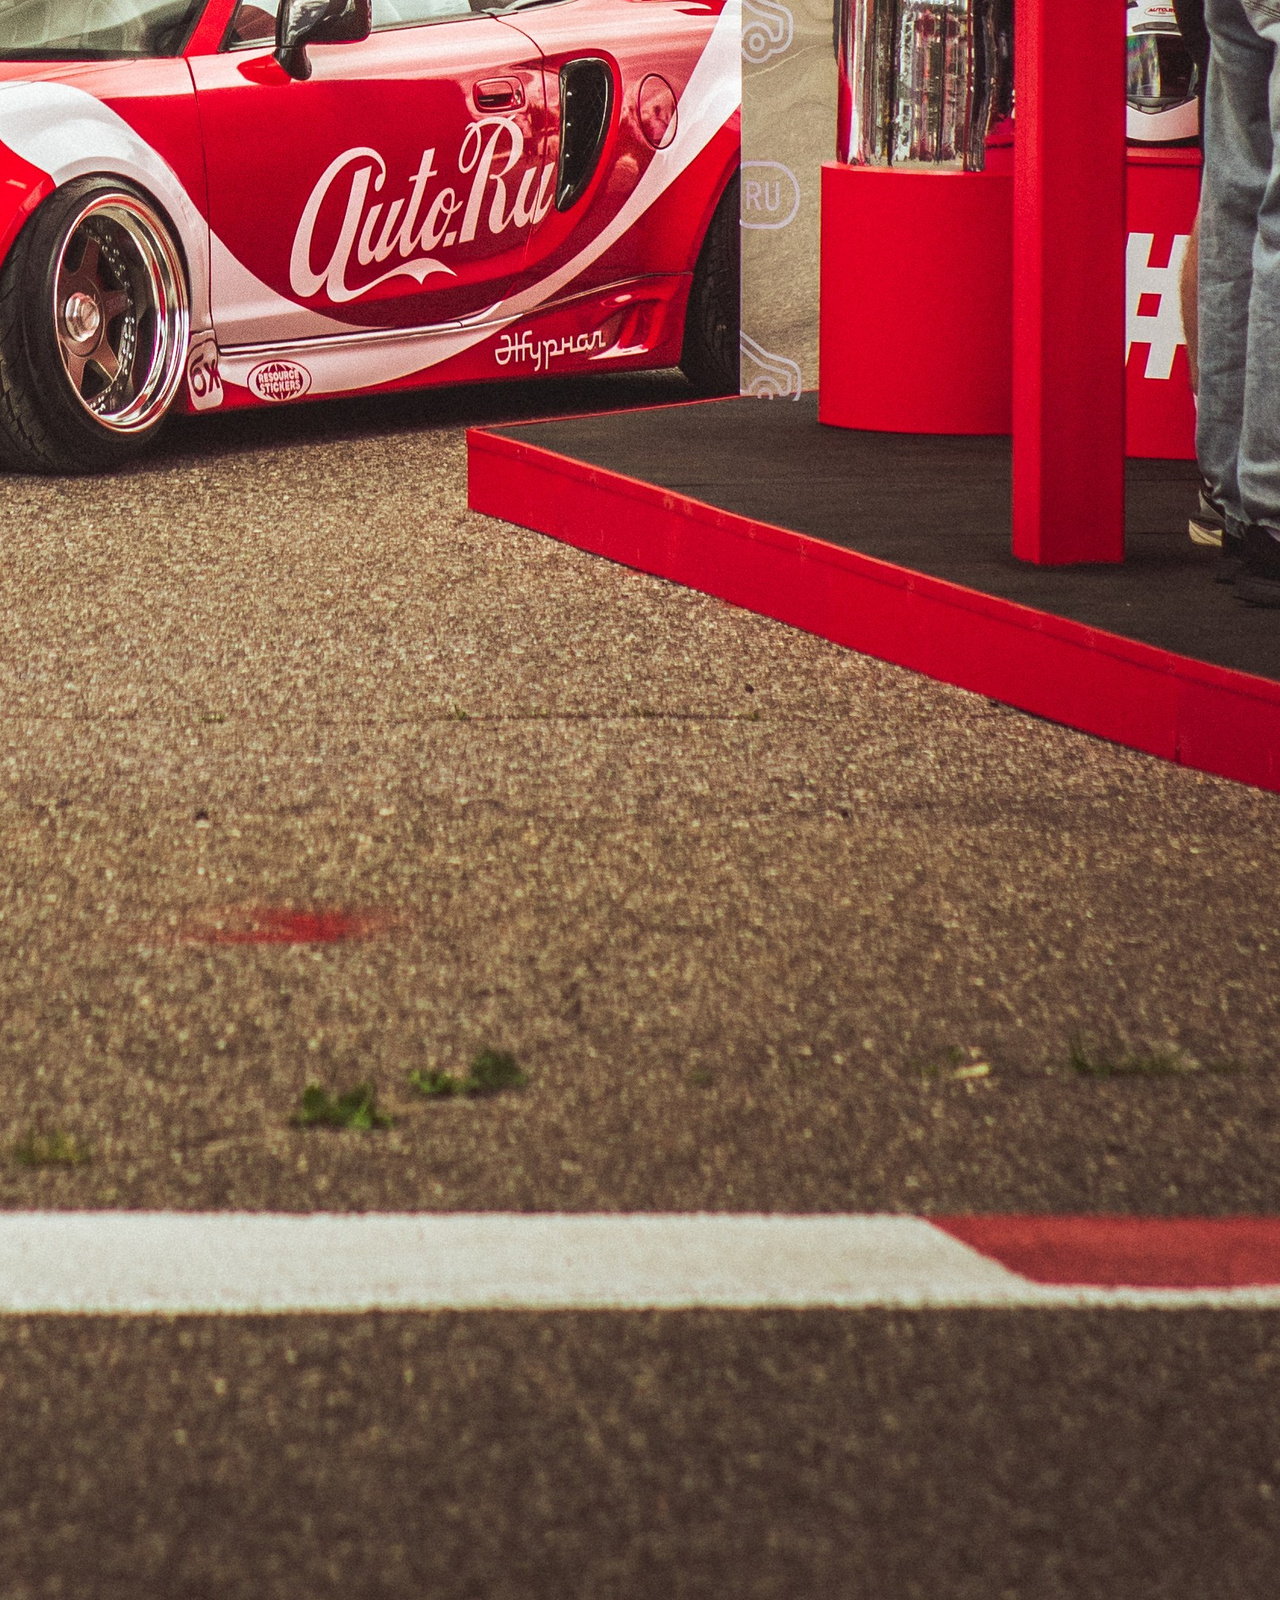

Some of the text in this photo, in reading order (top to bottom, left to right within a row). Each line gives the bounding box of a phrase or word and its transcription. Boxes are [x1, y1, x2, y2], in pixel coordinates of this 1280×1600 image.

[289, 114, 556, 303] Auto.Ru
[745, 180, 781, 211] RU
[495, 330, 606, 372] Журнал
[258, 368, 300, 383] RESOURCE
[260, 380, 301, 394] STICKERS
